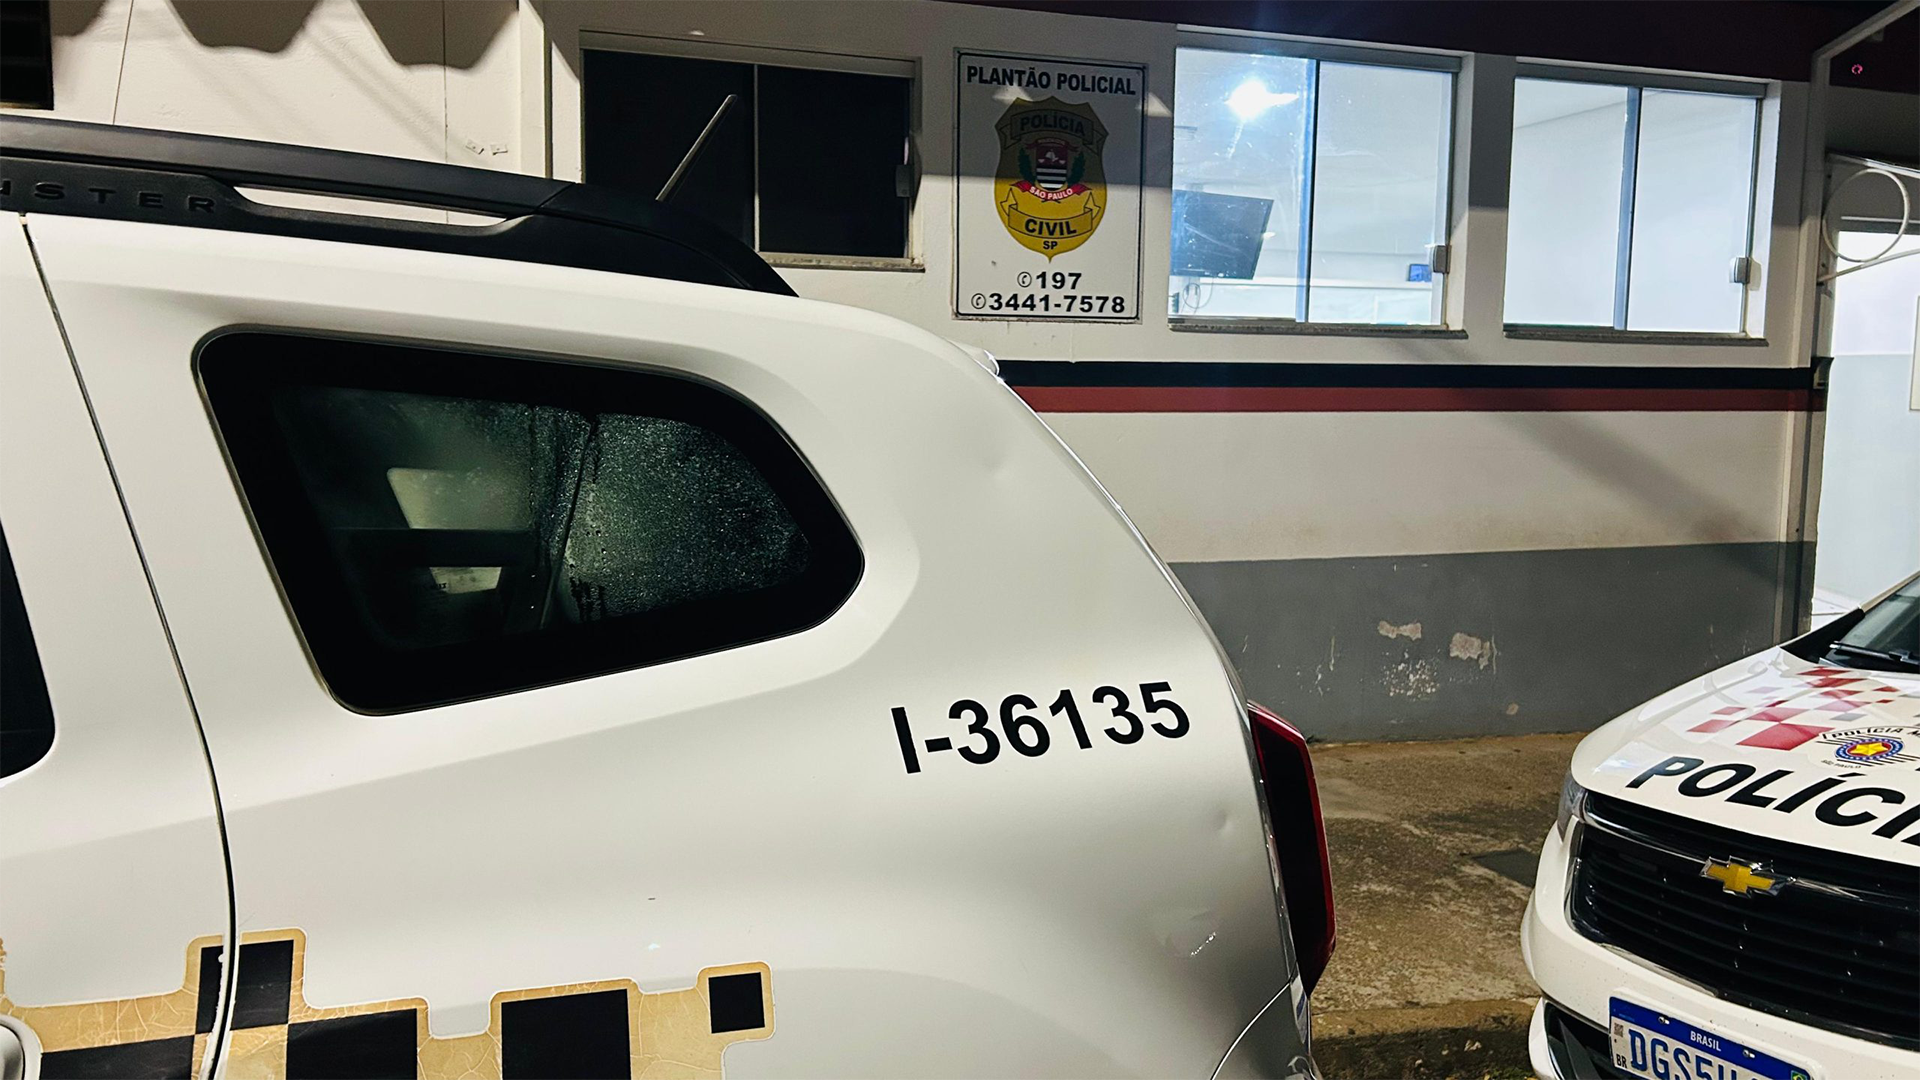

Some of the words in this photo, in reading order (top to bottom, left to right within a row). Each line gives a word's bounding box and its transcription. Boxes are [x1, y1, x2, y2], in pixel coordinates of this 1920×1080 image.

[966, 65, 1051, 90] PLANTÃO
[1056, 72, 1136, 96] POLICIAL
[1020, 111, 1086, 137] POLÍCIA
[1047, 187, 1074, 200] PAULO
[1024, 218, 1077, 236] CIVIL
[1042, 240, 1058, 250] SP
[1035, 271, 1082, 290] 197
[988, 292, 1125, 313] 3441-7578
[890, 681, 1190, 774] I-36135
[1626, 755, 1920, 847] POLÍCI
[1690, 1030, 1722, 1052] BRASIL
[1616, 1053, 1628, 1069] BR
